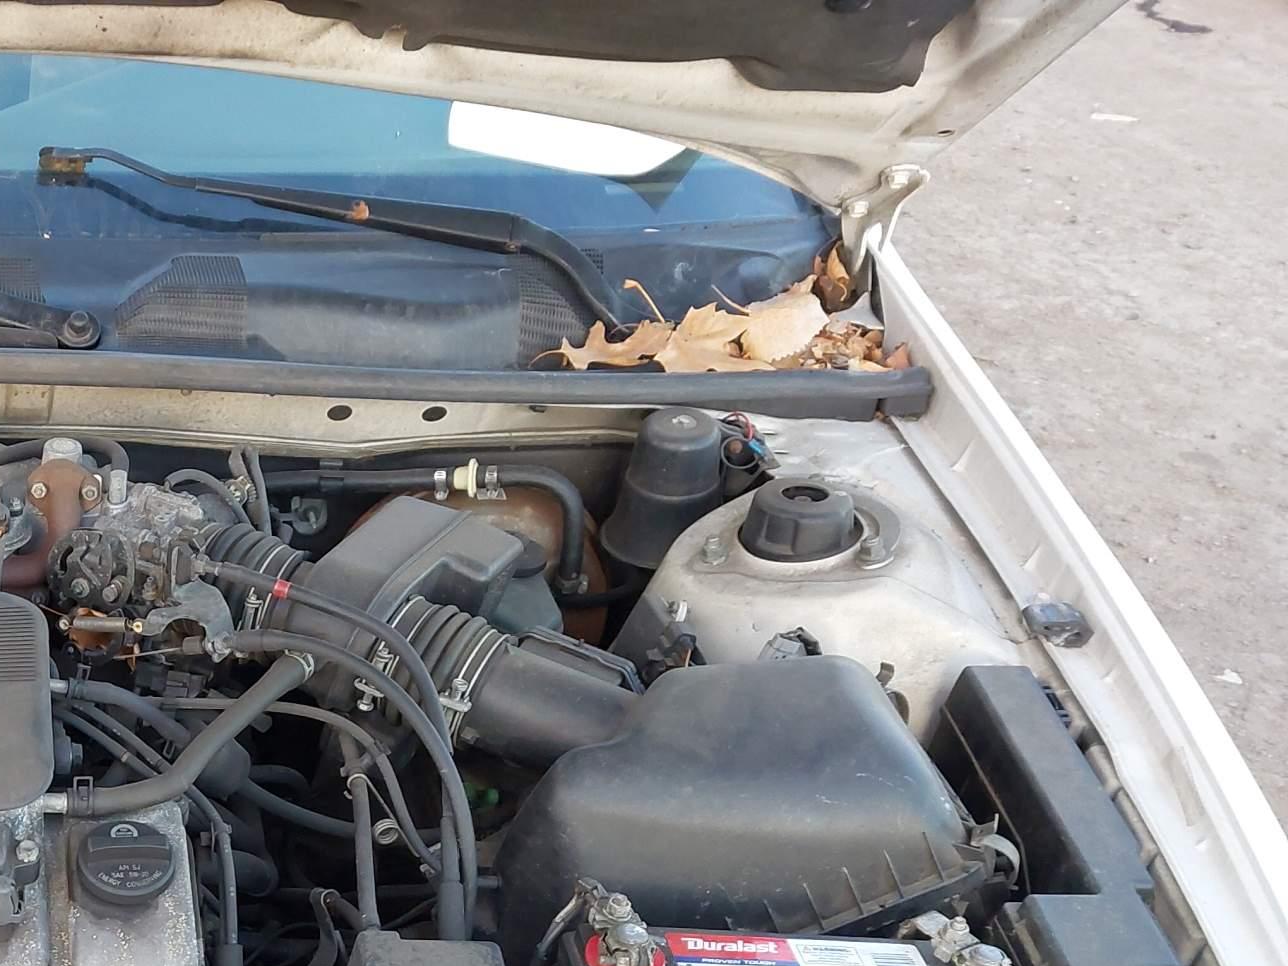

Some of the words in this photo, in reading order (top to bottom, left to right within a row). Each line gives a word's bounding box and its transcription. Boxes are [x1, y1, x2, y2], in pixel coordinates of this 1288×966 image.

[680, 936, 779, 954] Duralast
[701, 957, 742, 965] PROVEN
[743, 959, 777, 966] TOUGH
